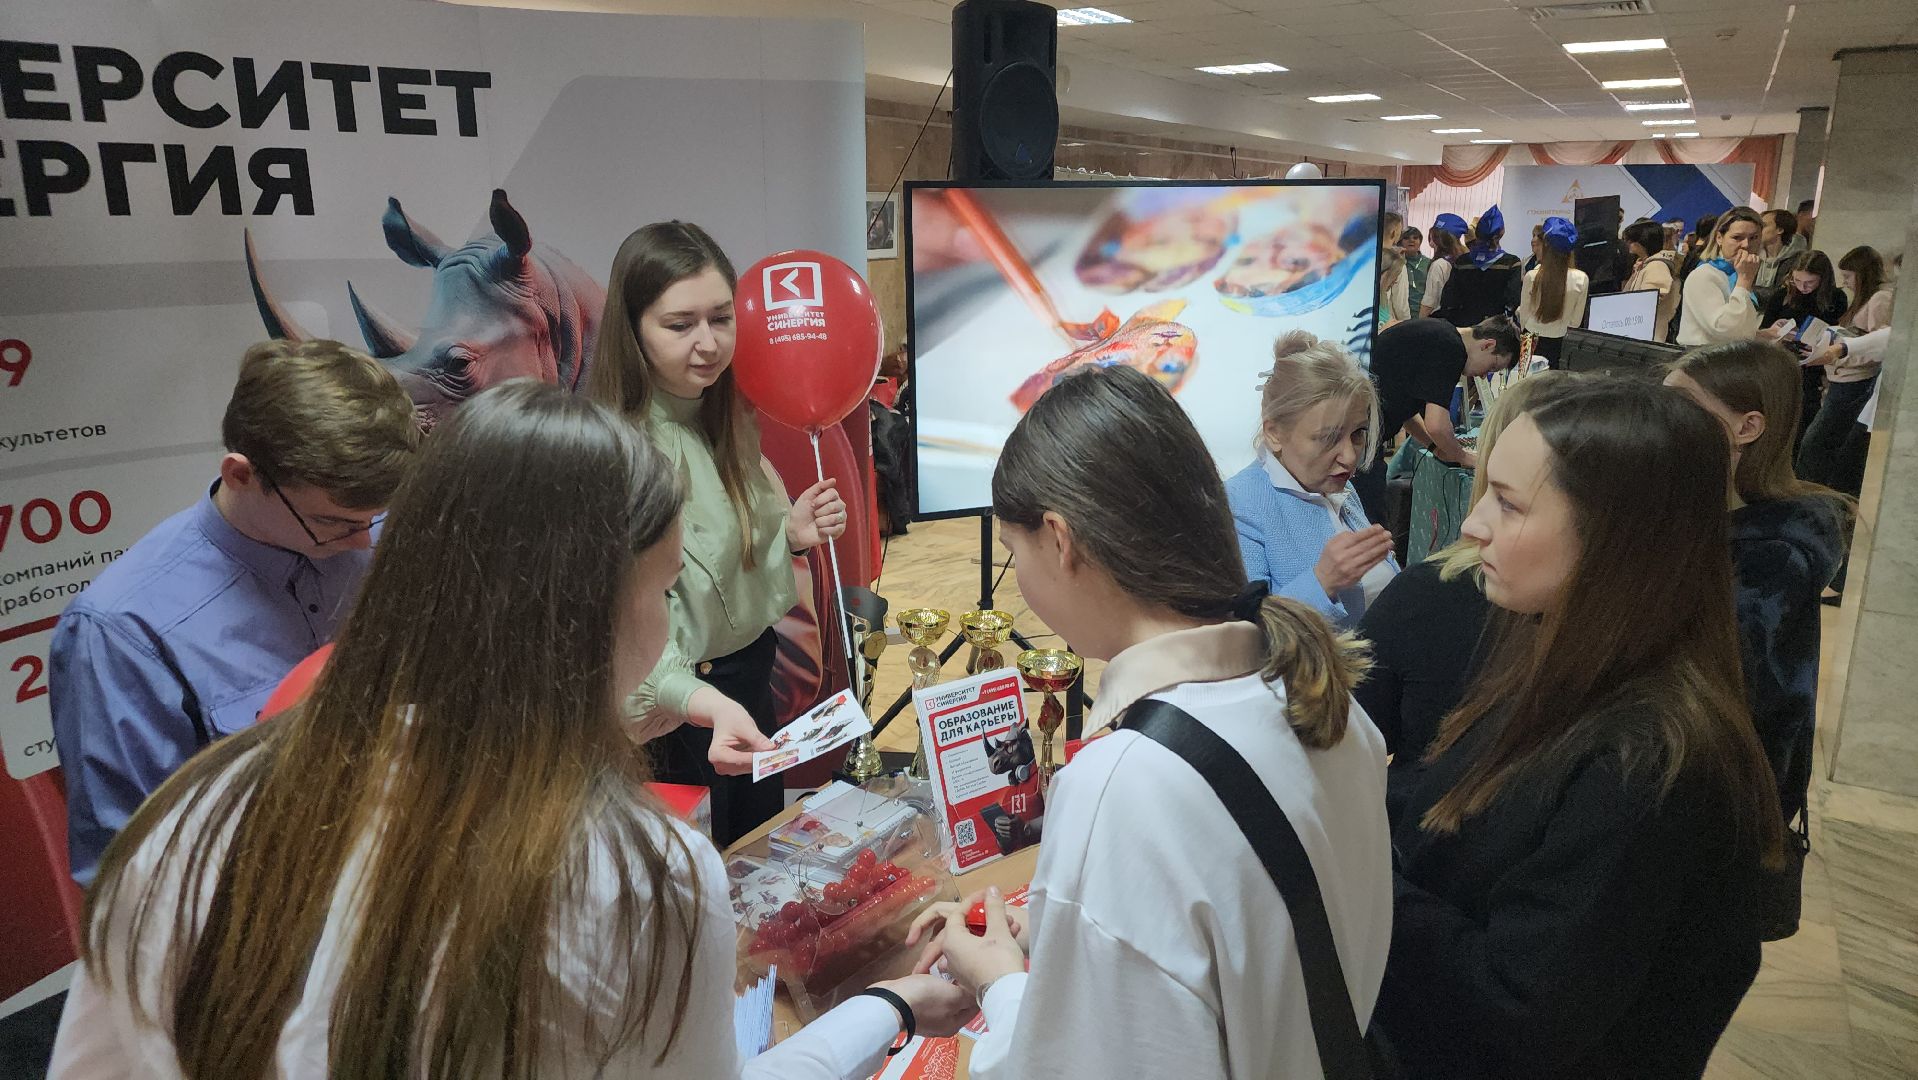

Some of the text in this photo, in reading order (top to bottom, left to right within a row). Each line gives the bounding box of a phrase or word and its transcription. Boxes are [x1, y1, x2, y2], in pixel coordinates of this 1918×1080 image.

[0, 139, 315, 217] РГИЯ
[766, 311, 825, 322] УНИВЕИТЕТ
[767, 318, 825, 331] СИНЕРГИЯ
[934, 686, 976, 702] УНИВЕРСИТЕТ
[936, 694, 967, 708] СИНЕРГИЯ
[938, 700, 1015, 730] ОБРАЗОВАНИЕ
[940, 711, 1017, 743] ДЛЯ КАРЬЕРЫ
